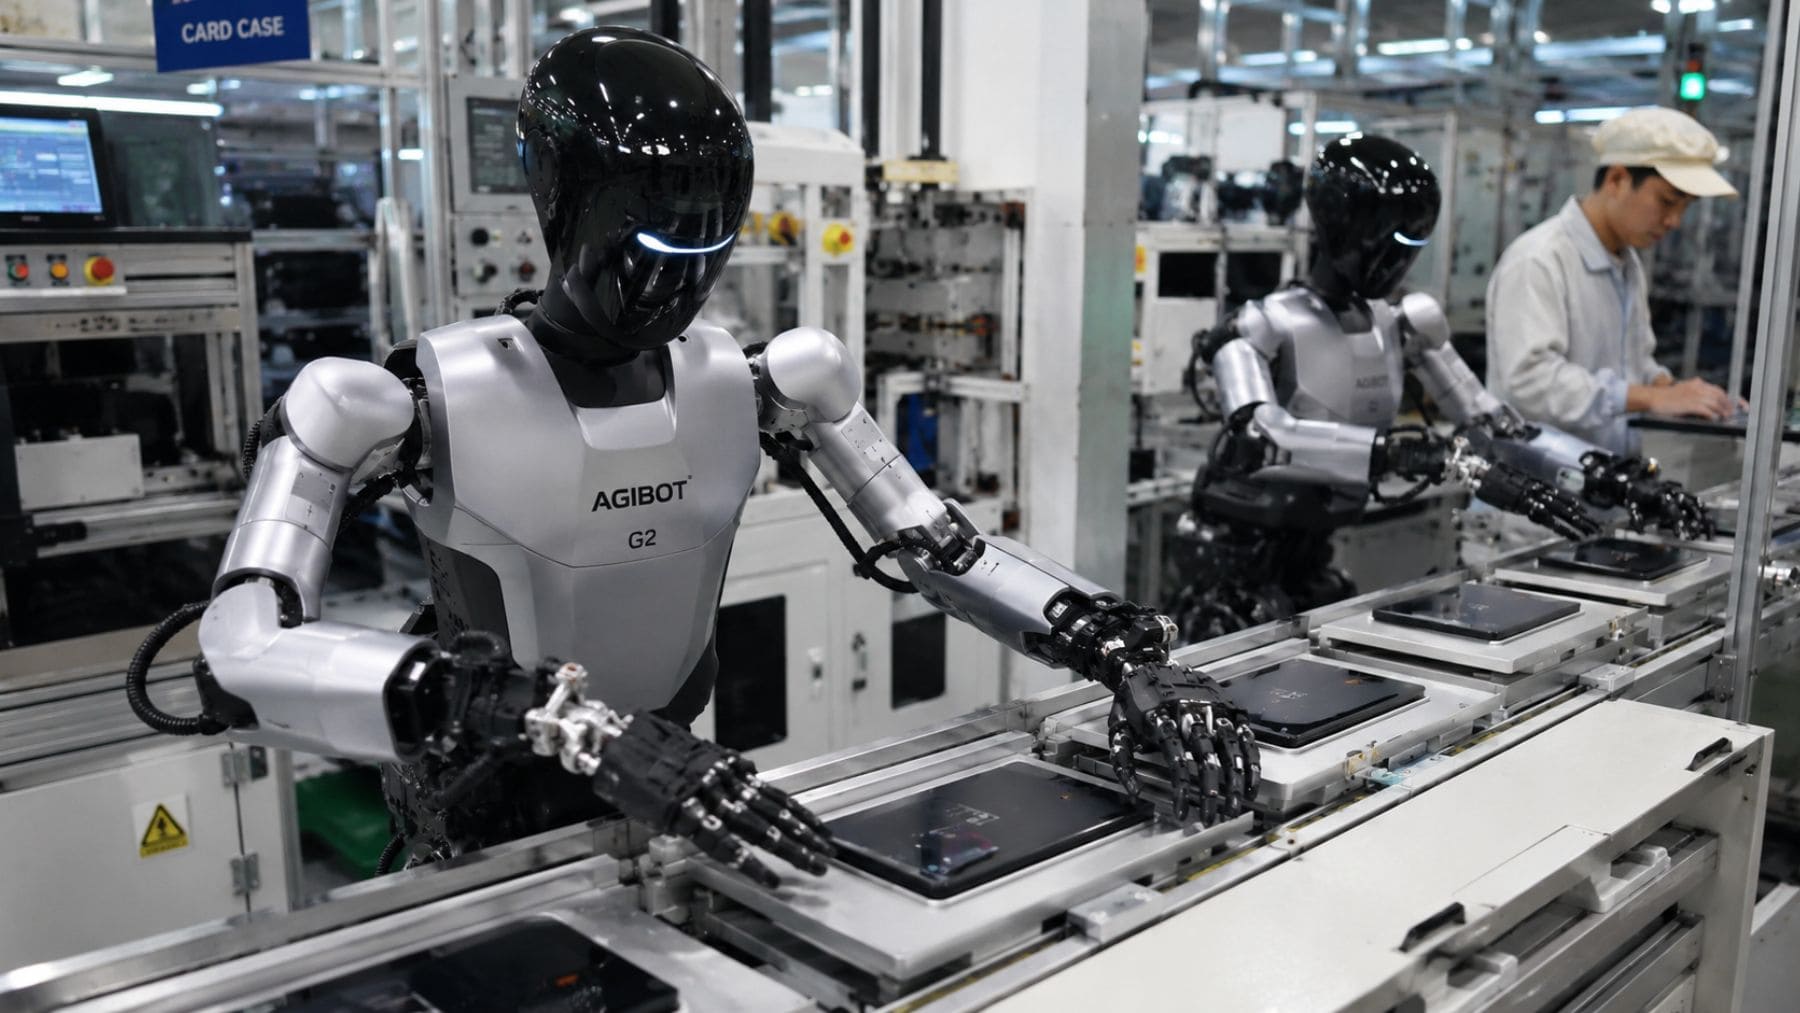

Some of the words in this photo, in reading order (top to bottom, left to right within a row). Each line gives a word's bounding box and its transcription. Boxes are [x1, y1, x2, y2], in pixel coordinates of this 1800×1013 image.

[181, 21, 232, 44] CARD
[237, 15, 285, 39] CASE
[591, 480, 688, 512] AGIBOT
[628, 529, 656, 549] G2
